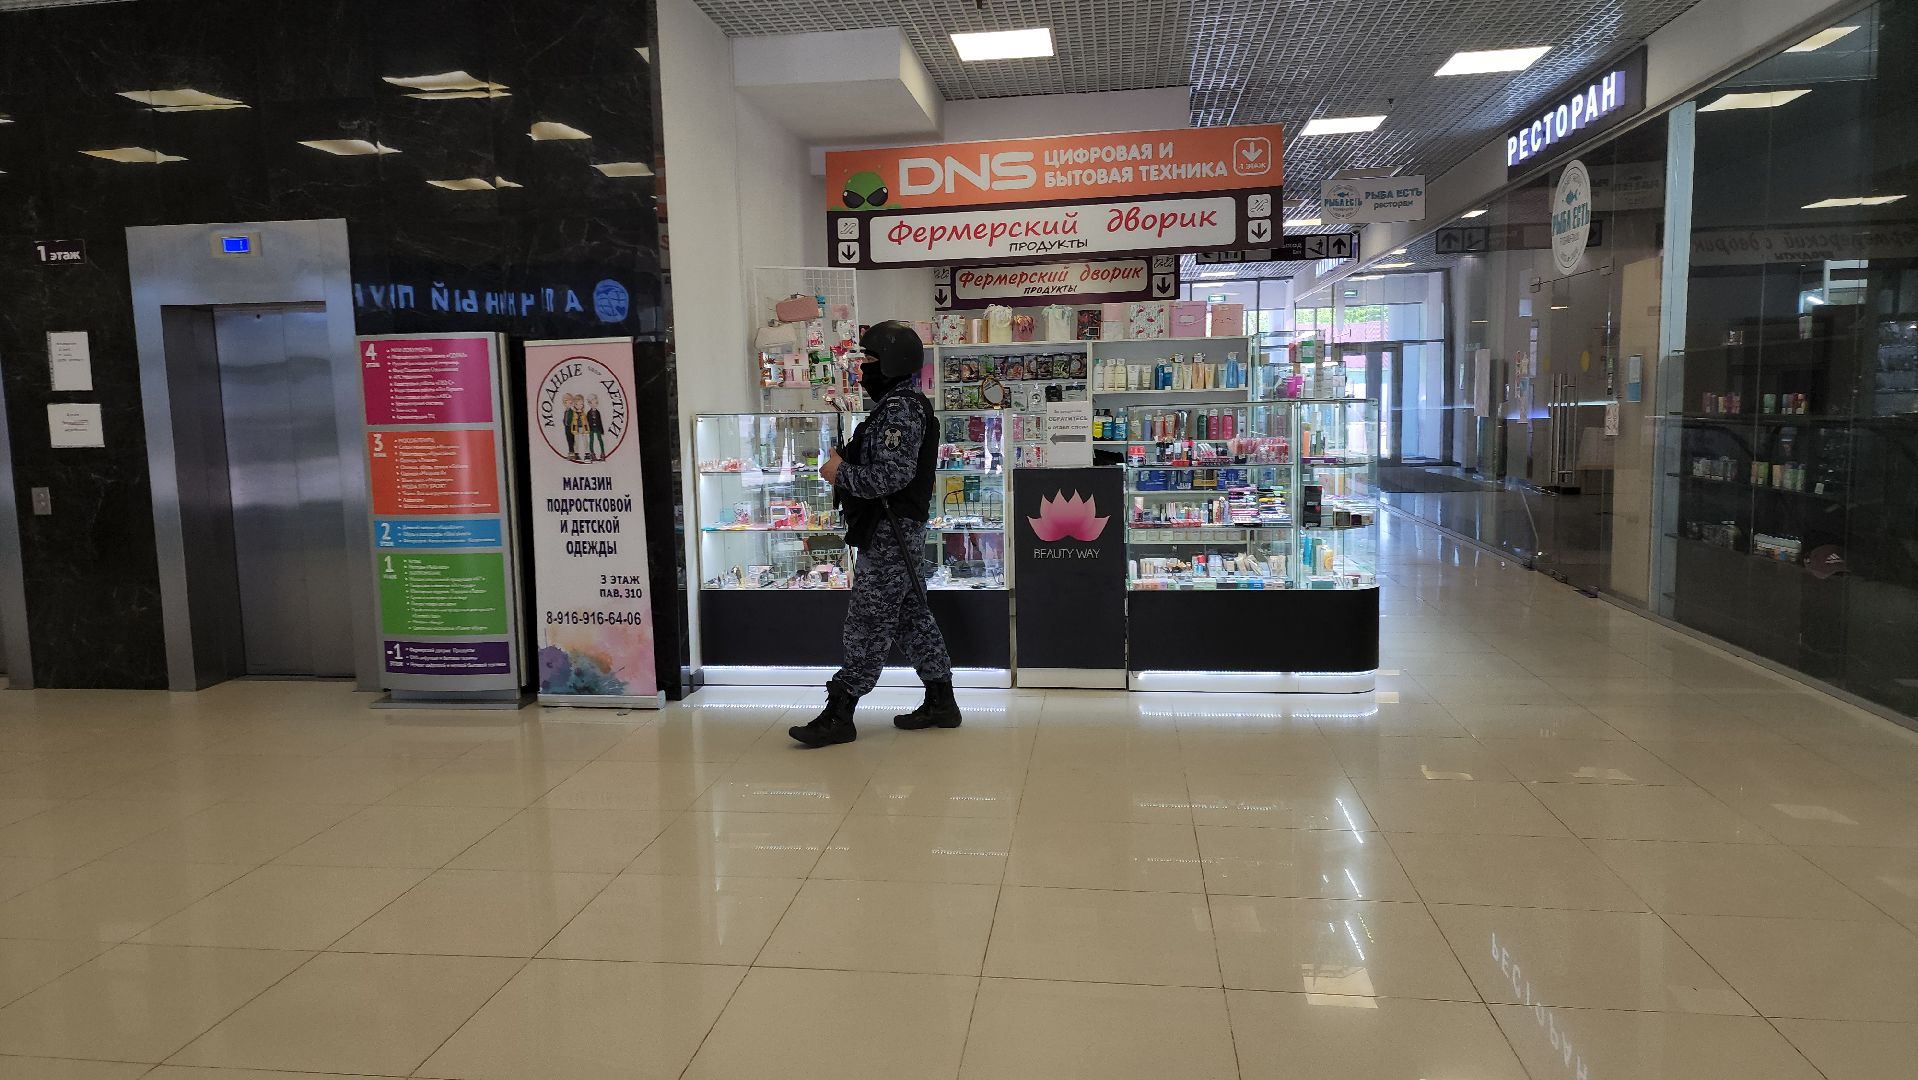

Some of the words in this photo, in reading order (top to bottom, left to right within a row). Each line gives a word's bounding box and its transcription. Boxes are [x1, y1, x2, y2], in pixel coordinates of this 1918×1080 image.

[1507, 71, 1618, 167] РЕСТОРАН
[1044, 142, 1153, 168] ЦИФРОВАЯ
[1159, 142, 1174, 158] И
[898, 151, 1037, 196] DNS
[1044, 166, 1133, 188] БЫТОВАЯ
[1139, 160, 1228, 182] ТЕХНИКА
[1364, 190, 1394, 200] РЫБА
[1396, 187, 1423, 198] ЕСТЬ
[1373, 200, 1414, 211] ресторан
[887, 211, 1079, 250] Фермерский
[1107, 206, 1217, 238] дворик
[37, 245, 46, 262] 1
[50, 250, 81, 261] этаж
[1009, 238, 1089, 253] ПРОДУКТЫ
[959, 265, 1069, 289] Фермерский
[1079, 263, 1144, 284] дворик
[1023, 284, 1078, 295] ПРОДУКТЫ
[365, 343, 377, 361] 4
[541, 363, 583, 428] МОДНЫЕ
[600, 379, 624, 439] ДЕТКИ
[373, 434, 384, 452] 3
[563, 477, 612, 491] МАГАЗИН
[547, 494, 632, 515] ПОДРОСТКОВОЙ
[381, 522, 392, 540] 2
[560, 520, 568, 533] И
[571, 516, 620, 536] ДЕТСКОЙ
[566, 541, 617, 557] ОДЕЖДЫ
[1034, 548, 1074, 559] BEAUTY
[1076, 548, 1100, 559] WAY
[384, 555, 395, 573] 1
[600, 575, 607, 584] 3
[611, 575, 640, 585] ЭТАЖ
[600, 588, 622, 598] ПАВ.
[625, 589, 642, 598] 310
[546, 611, 642, 625] 8-916-916-64-06
[386, 643, 403, 660] -1
